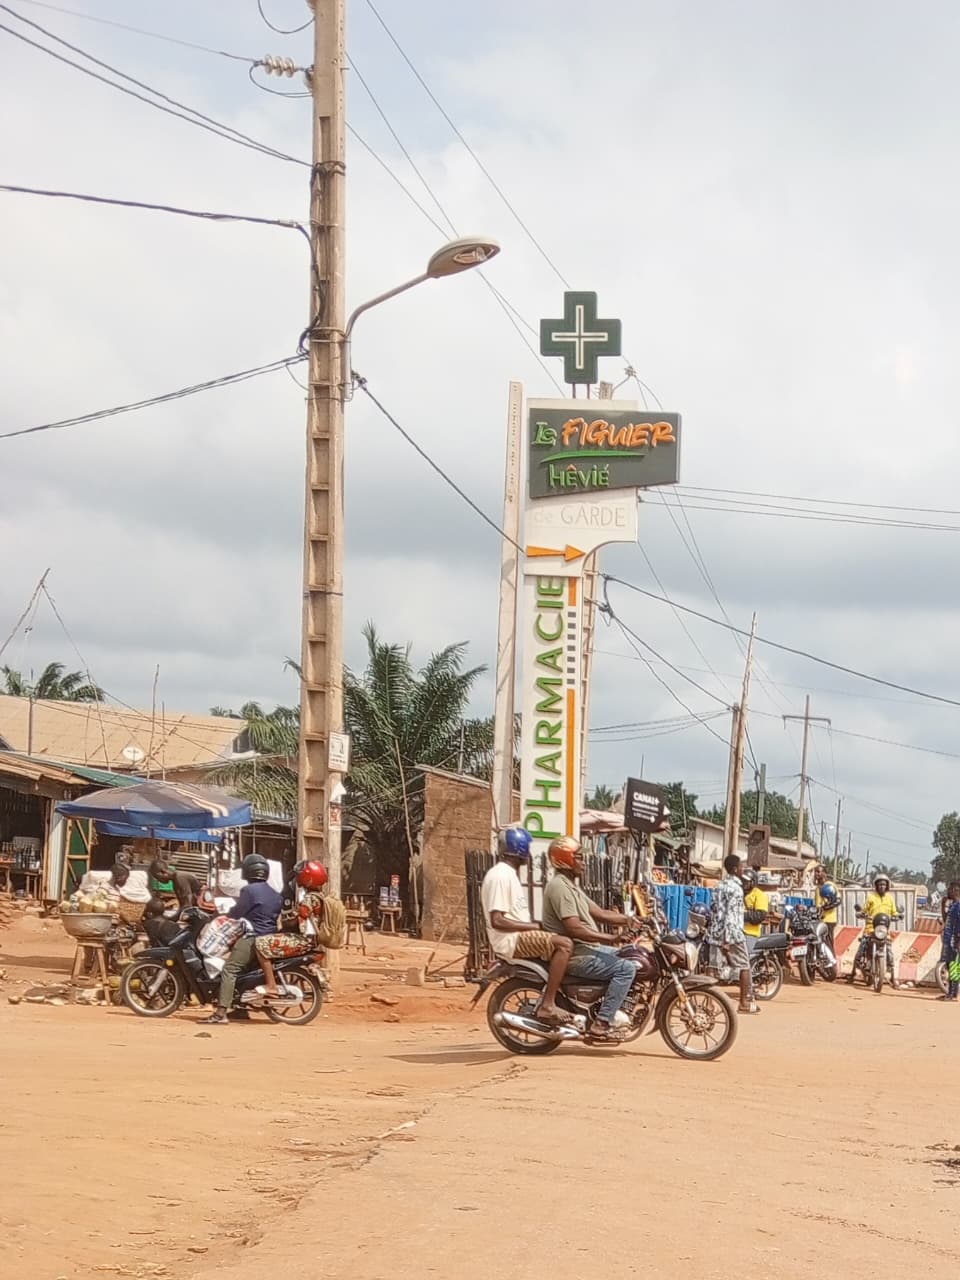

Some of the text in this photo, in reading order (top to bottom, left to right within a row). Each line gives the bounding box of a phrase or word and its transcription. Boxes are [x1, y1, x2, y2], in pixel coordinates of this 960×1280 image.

[561, 417, 676, 448] FIGUIER
[560, 504, 626, 527] GARDE
[523, 575, 566, 840] PHARMACIE
